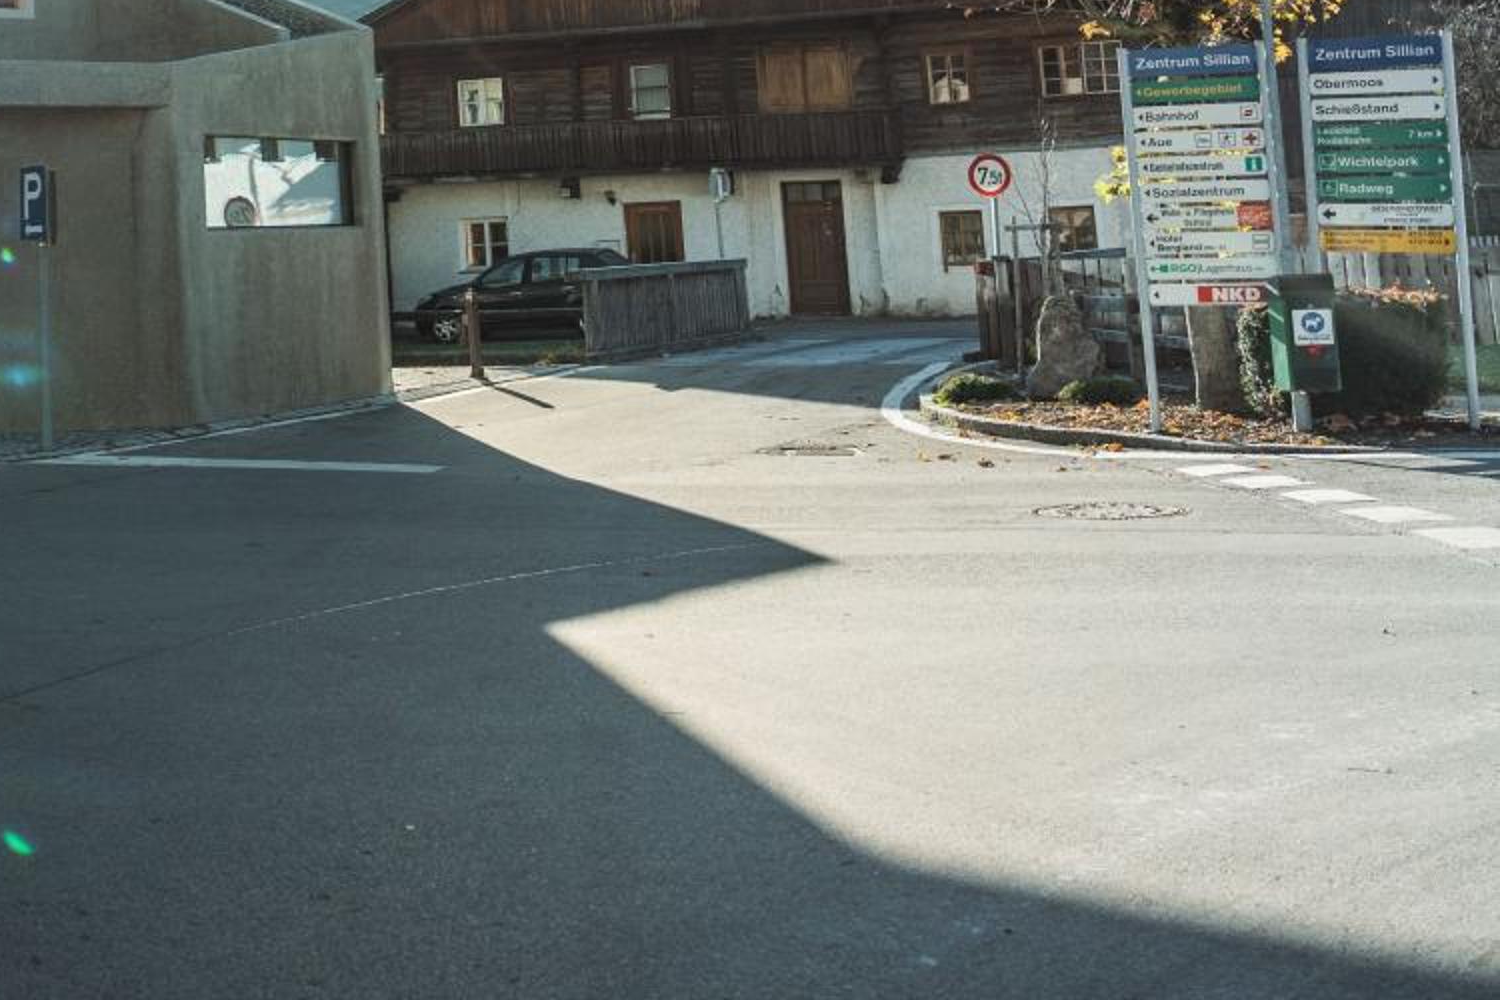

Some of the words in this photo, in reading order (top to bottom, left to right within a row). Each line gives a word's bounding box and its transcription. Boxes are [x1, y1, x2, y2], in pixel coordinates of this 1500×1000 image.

[1315, 47, 1381, 61] Zentrum
[1385, 44, 1435, 57] Sillian
[1135, 57, 1199, 71] Zentrum
[1203, 54, 1250, 67] Sillian
[1313, 77, 1384, 89] Obermoos
[1143, 84, 1242, 99] Gewerbegebiet
[1315, 103, 1399, 115] Schießstand
[1145, 110, 1199, 123] Bahnhof
[1148, 137, 1173, 147] Aue
[1337, 155, 1419, 169] Wichtelpark
[23, 171, 43, 221] P
[1152, 186, 1245, 200] Sozialzentrum
[1339, 183, 1394, 196] Radweg
[1211, 286, 1261, 303] NKD
